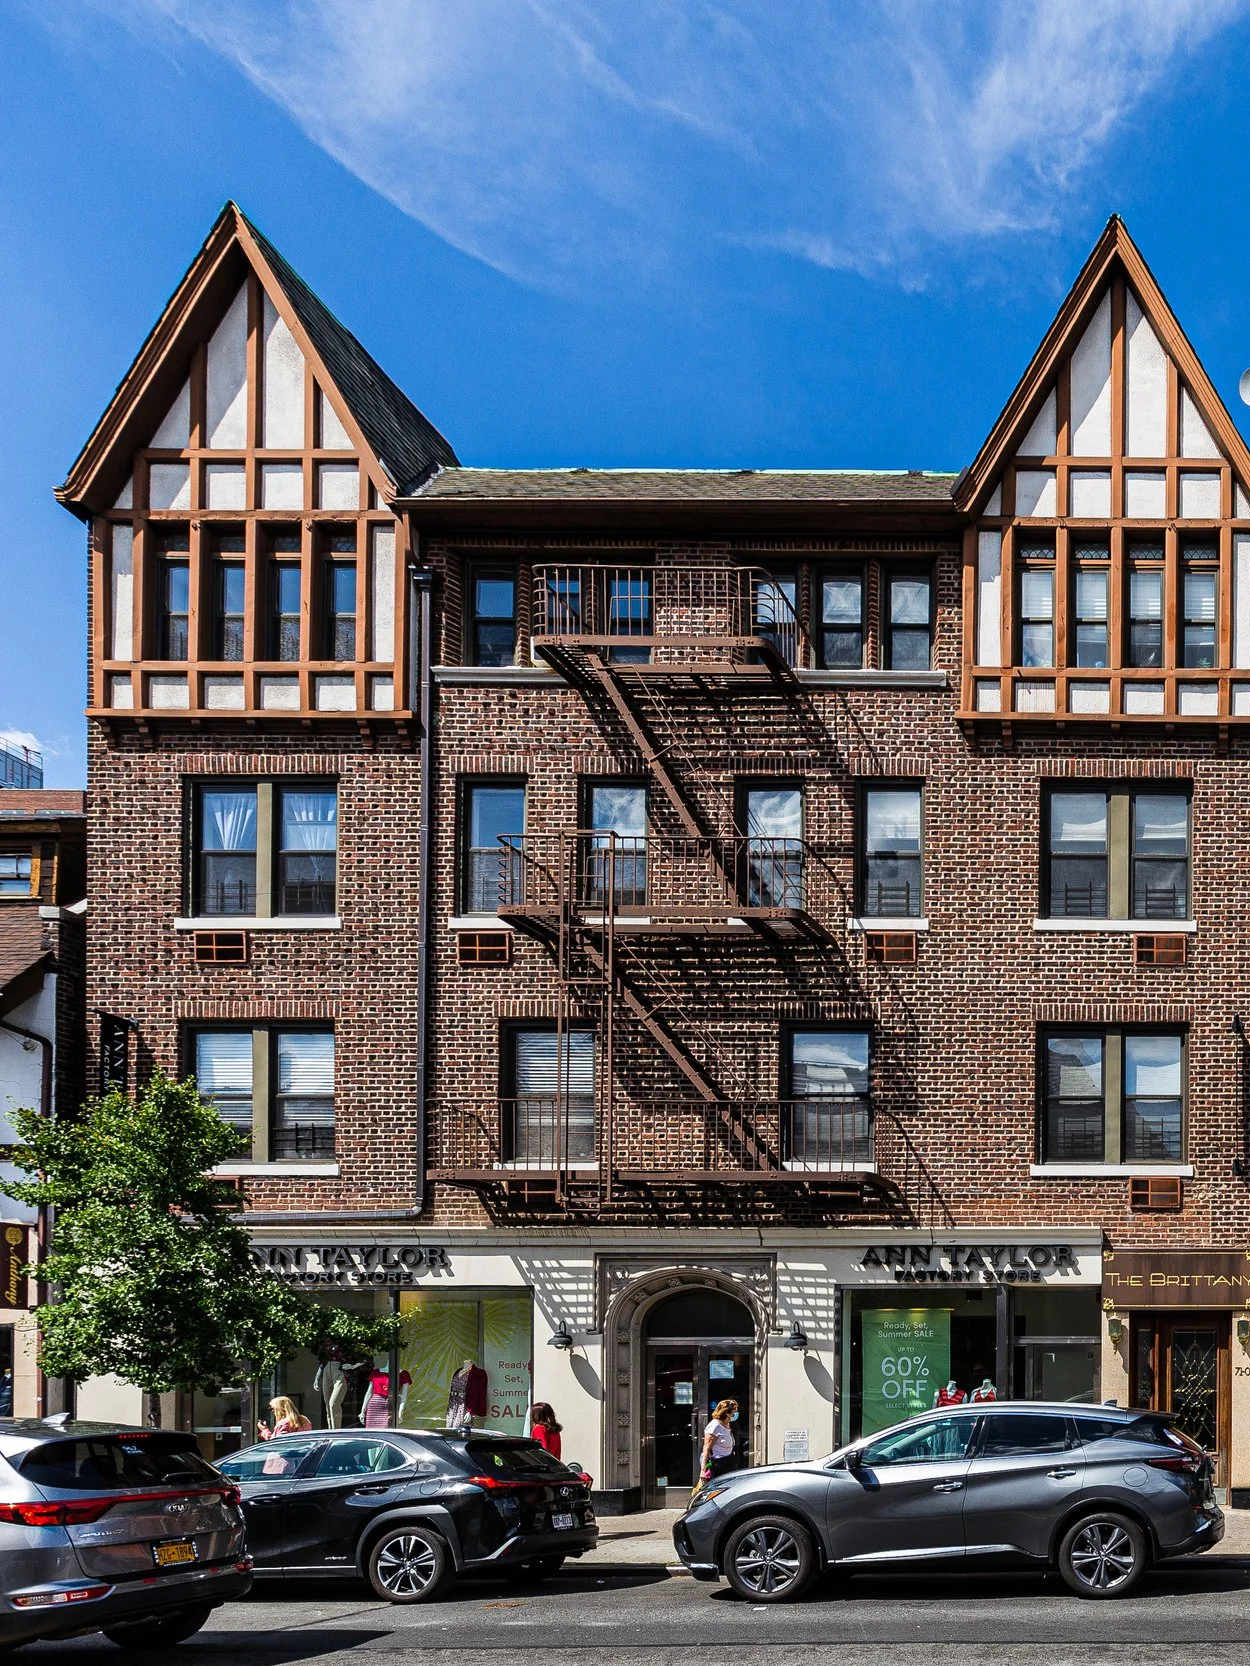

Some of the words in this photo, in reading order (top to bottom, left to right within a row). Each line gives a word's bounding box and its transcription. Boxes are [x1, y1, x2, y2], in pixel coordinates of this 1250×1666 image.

[114, 1025, 124, 1068] ANN
[251, 1247, 303, 1266] NN
[311, 1247, 447, 1266] TAYLOR
[860, 1245, 932, 1265] ANN
[944, 1245, 1076, 1266] TAYLOR
[272, 1271, 343, 1283] ACTORY
[351, 1271, 413, 1283] STORE
[894, 1270, 974, 1282] FACTORY
[983, 1270, 1041, 1282] STORE
[1105, 1273, 1143, 1286] THE
[884, 1322, 911, 1330] Ready,
[913, 1322, 929, 1330] Set,
[881, 1356, 930, 1377] 60%
[504, 1374, 524, 1384] Set,
[493, 1389, 528, 1397] Summe
[881, 1380, 928, 1399] OFF
[491, 1404, 528, 1418] SAL
